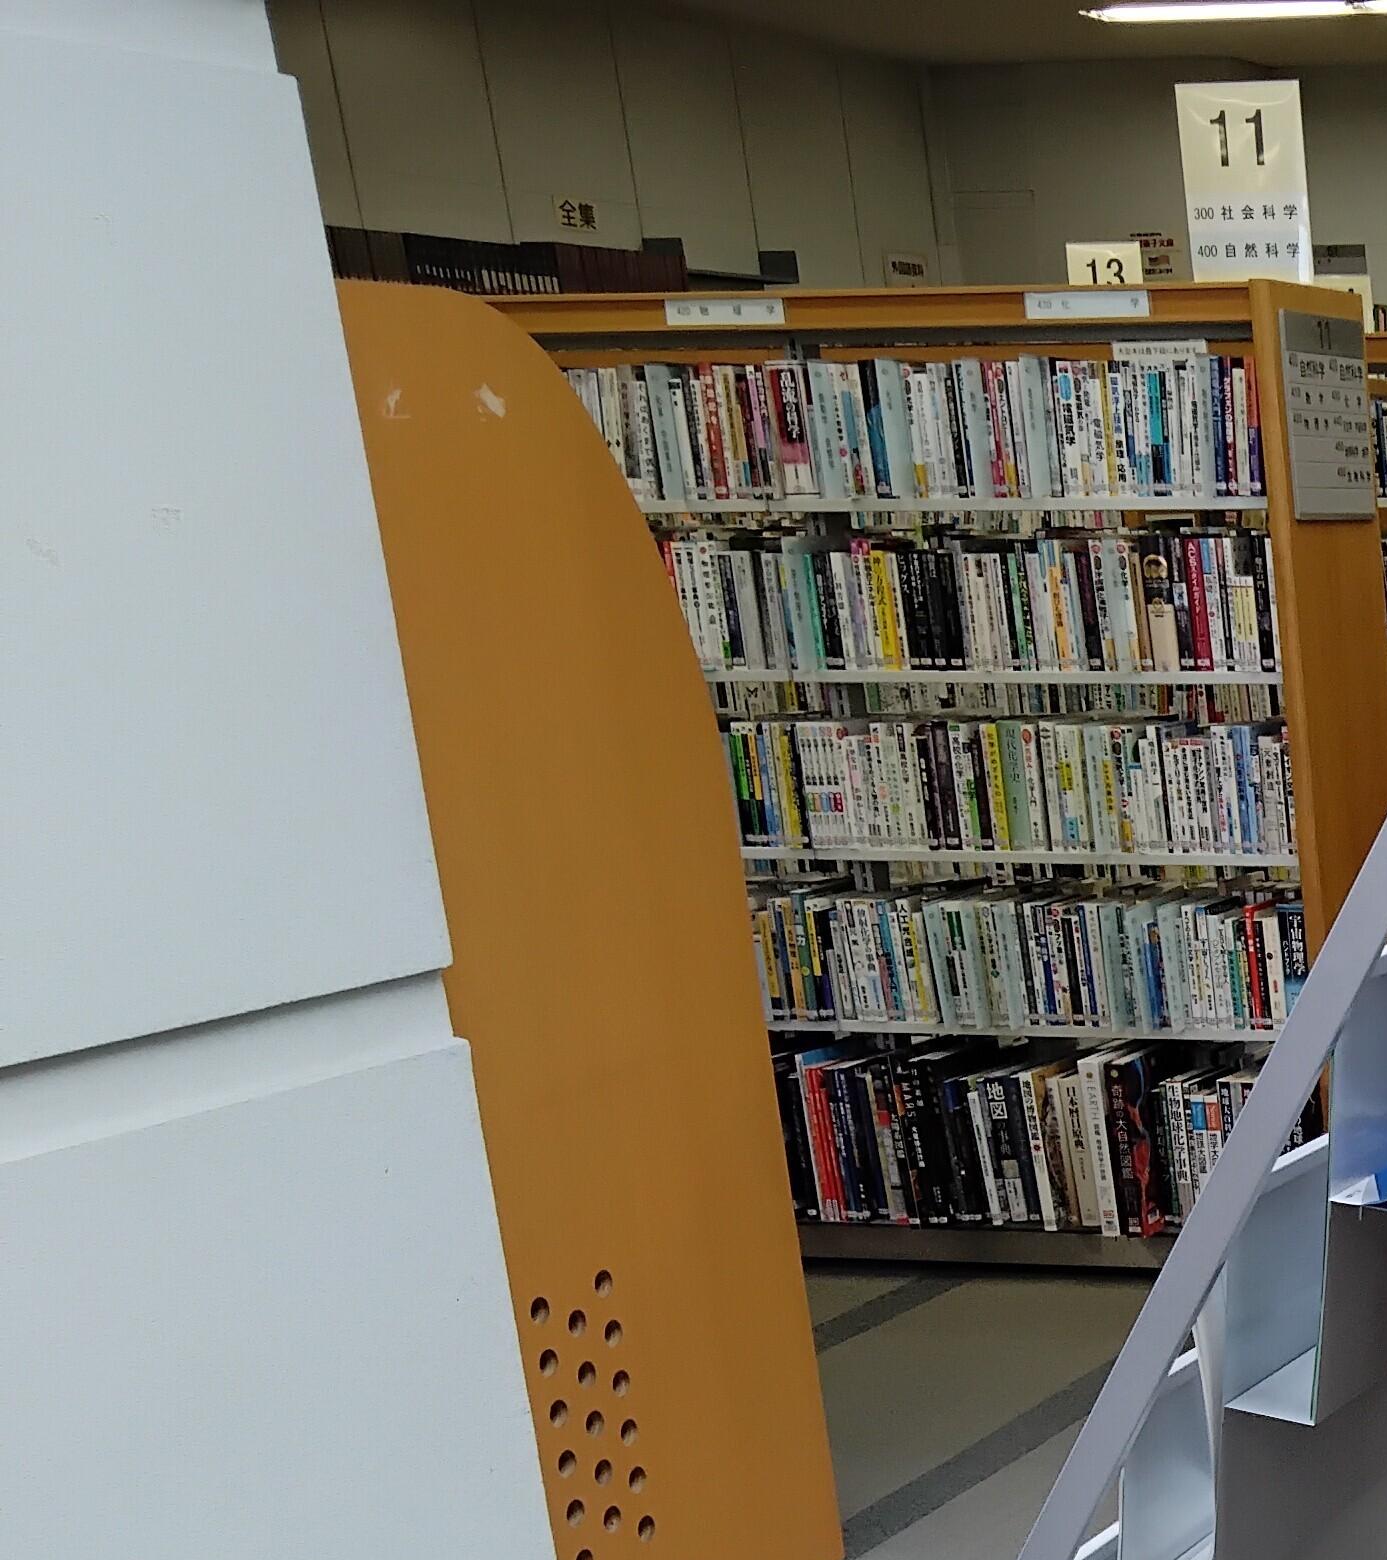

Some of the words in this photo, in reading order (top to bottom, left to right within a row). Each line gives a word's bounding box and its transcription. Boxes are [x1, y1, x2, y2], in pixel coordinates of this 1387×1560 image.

[1209, 108, 1268, 167] 11
[558, 199, 598, 231] 全集
[1193, 206, 1215, 221] 300
[1219, 203, 1299, 222] 社会科学
[1196, 243, 1219, 259] 400
[1224, 240, 1301, 260] 自然科学
[1086, 257, 1126, 285] 13
[1288, 914, 1307, 977] 宇宙物理学
[1167, 1083, 1190, 1182] 生物地球化学事典
